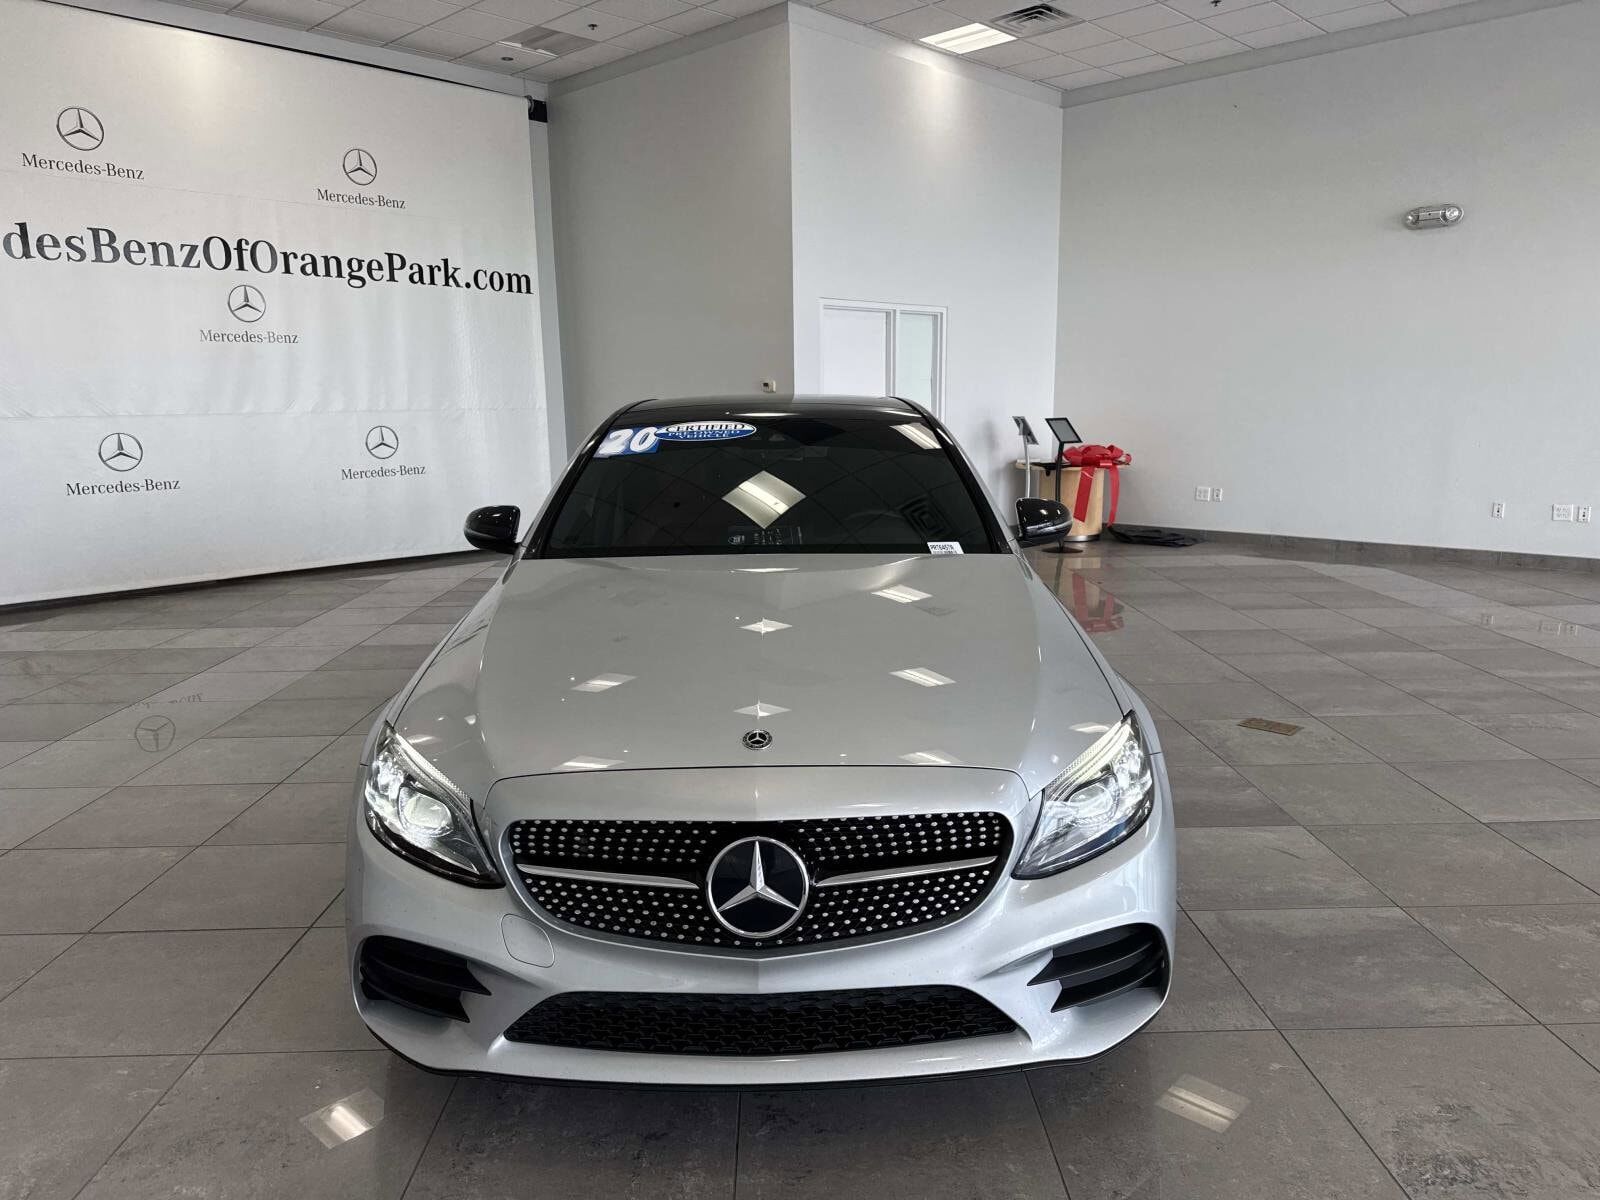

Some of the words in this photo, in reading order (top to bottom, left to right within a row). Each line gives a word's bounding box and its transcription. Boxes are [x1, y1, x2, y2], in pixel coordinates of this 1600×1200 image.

[22, 152, 144, 180] Mercedes-Benz
[317, 188, 406, 209] Mercedes-Benz
[2, 221, 533, 294] desBenzOfOrangePark.com
[200, 329, 299, 343] Mercedes-Benz
[665, 423, 745, 433] CERTIFIED
[598, 426, 657, 454] 20
[341, 464, 426, 480] Mercedes-Benz
[66, 478, 180, 496] Mercedes-Benz
